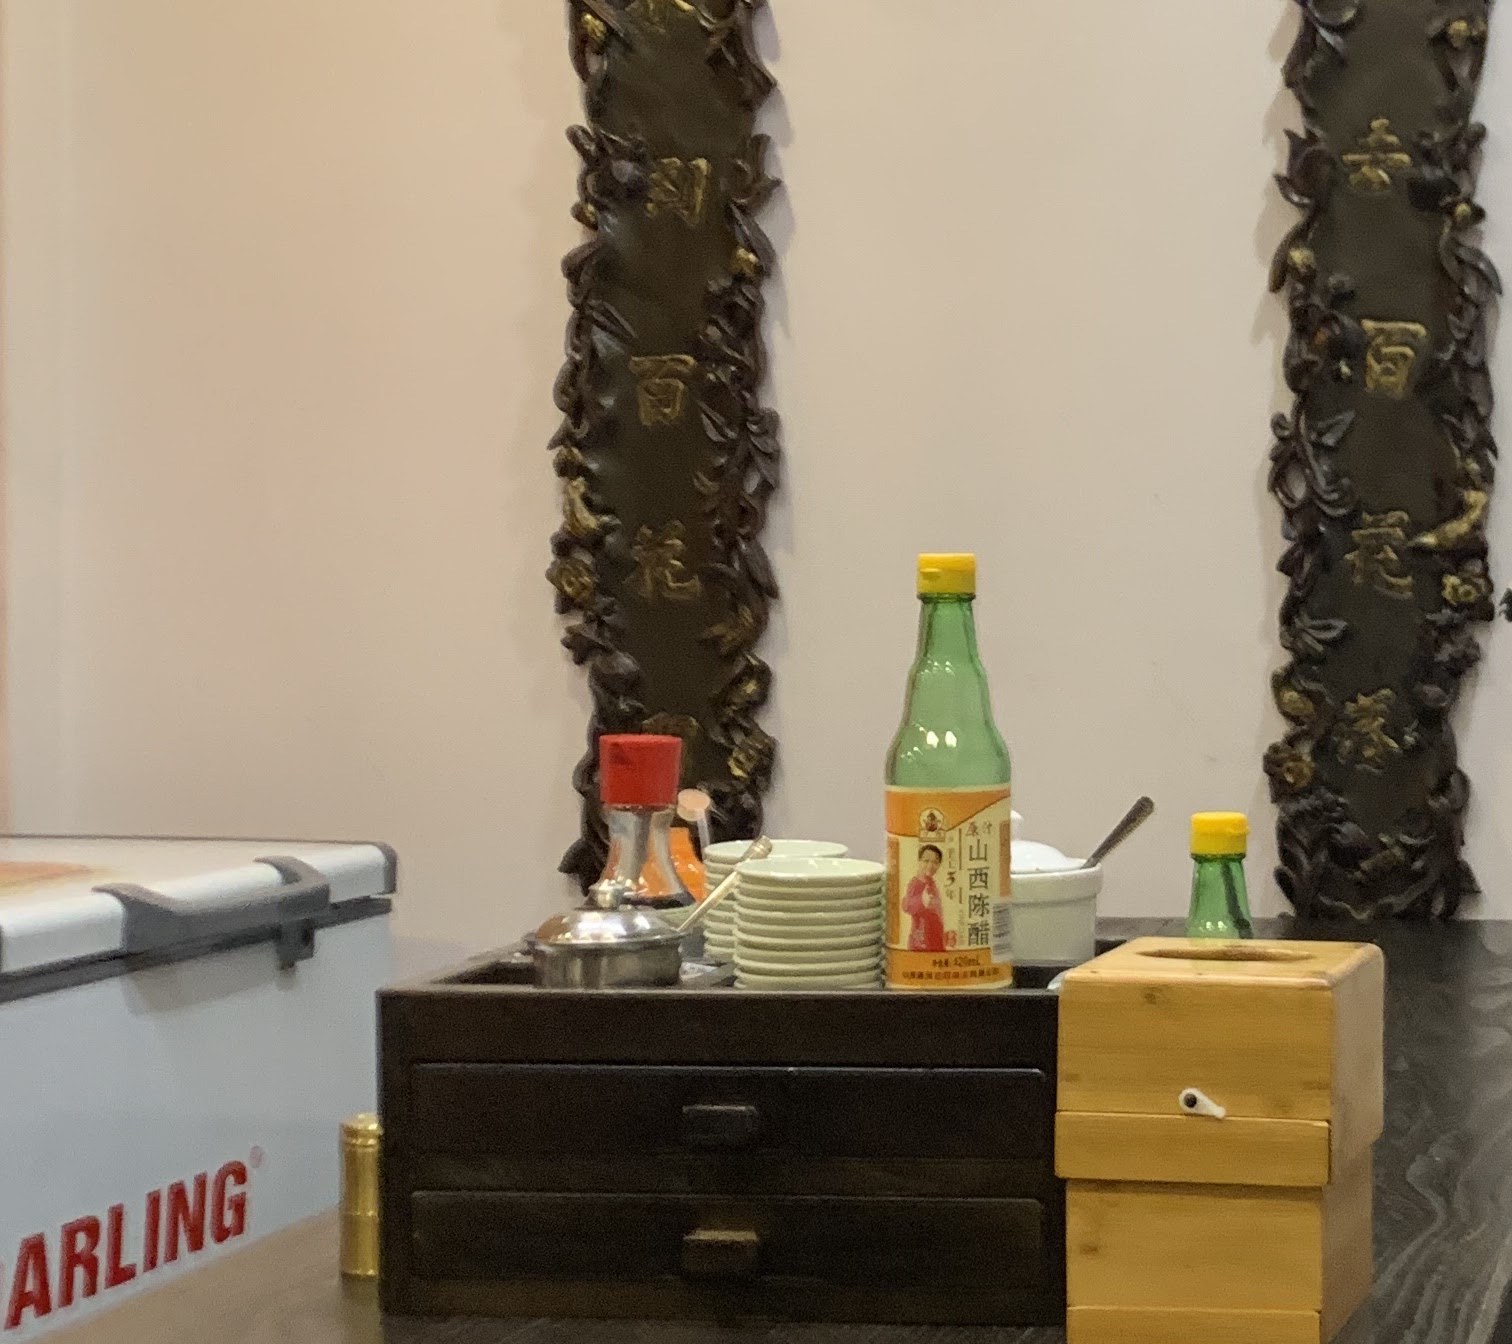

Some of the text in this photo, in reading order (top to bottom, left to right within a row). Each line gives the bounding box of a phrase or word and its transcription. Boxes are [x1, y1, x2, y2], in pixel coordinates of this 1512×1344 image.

[966, 838, 990, 947] 山西陈醋
[0, 1159, 248, 1330] ARLING
